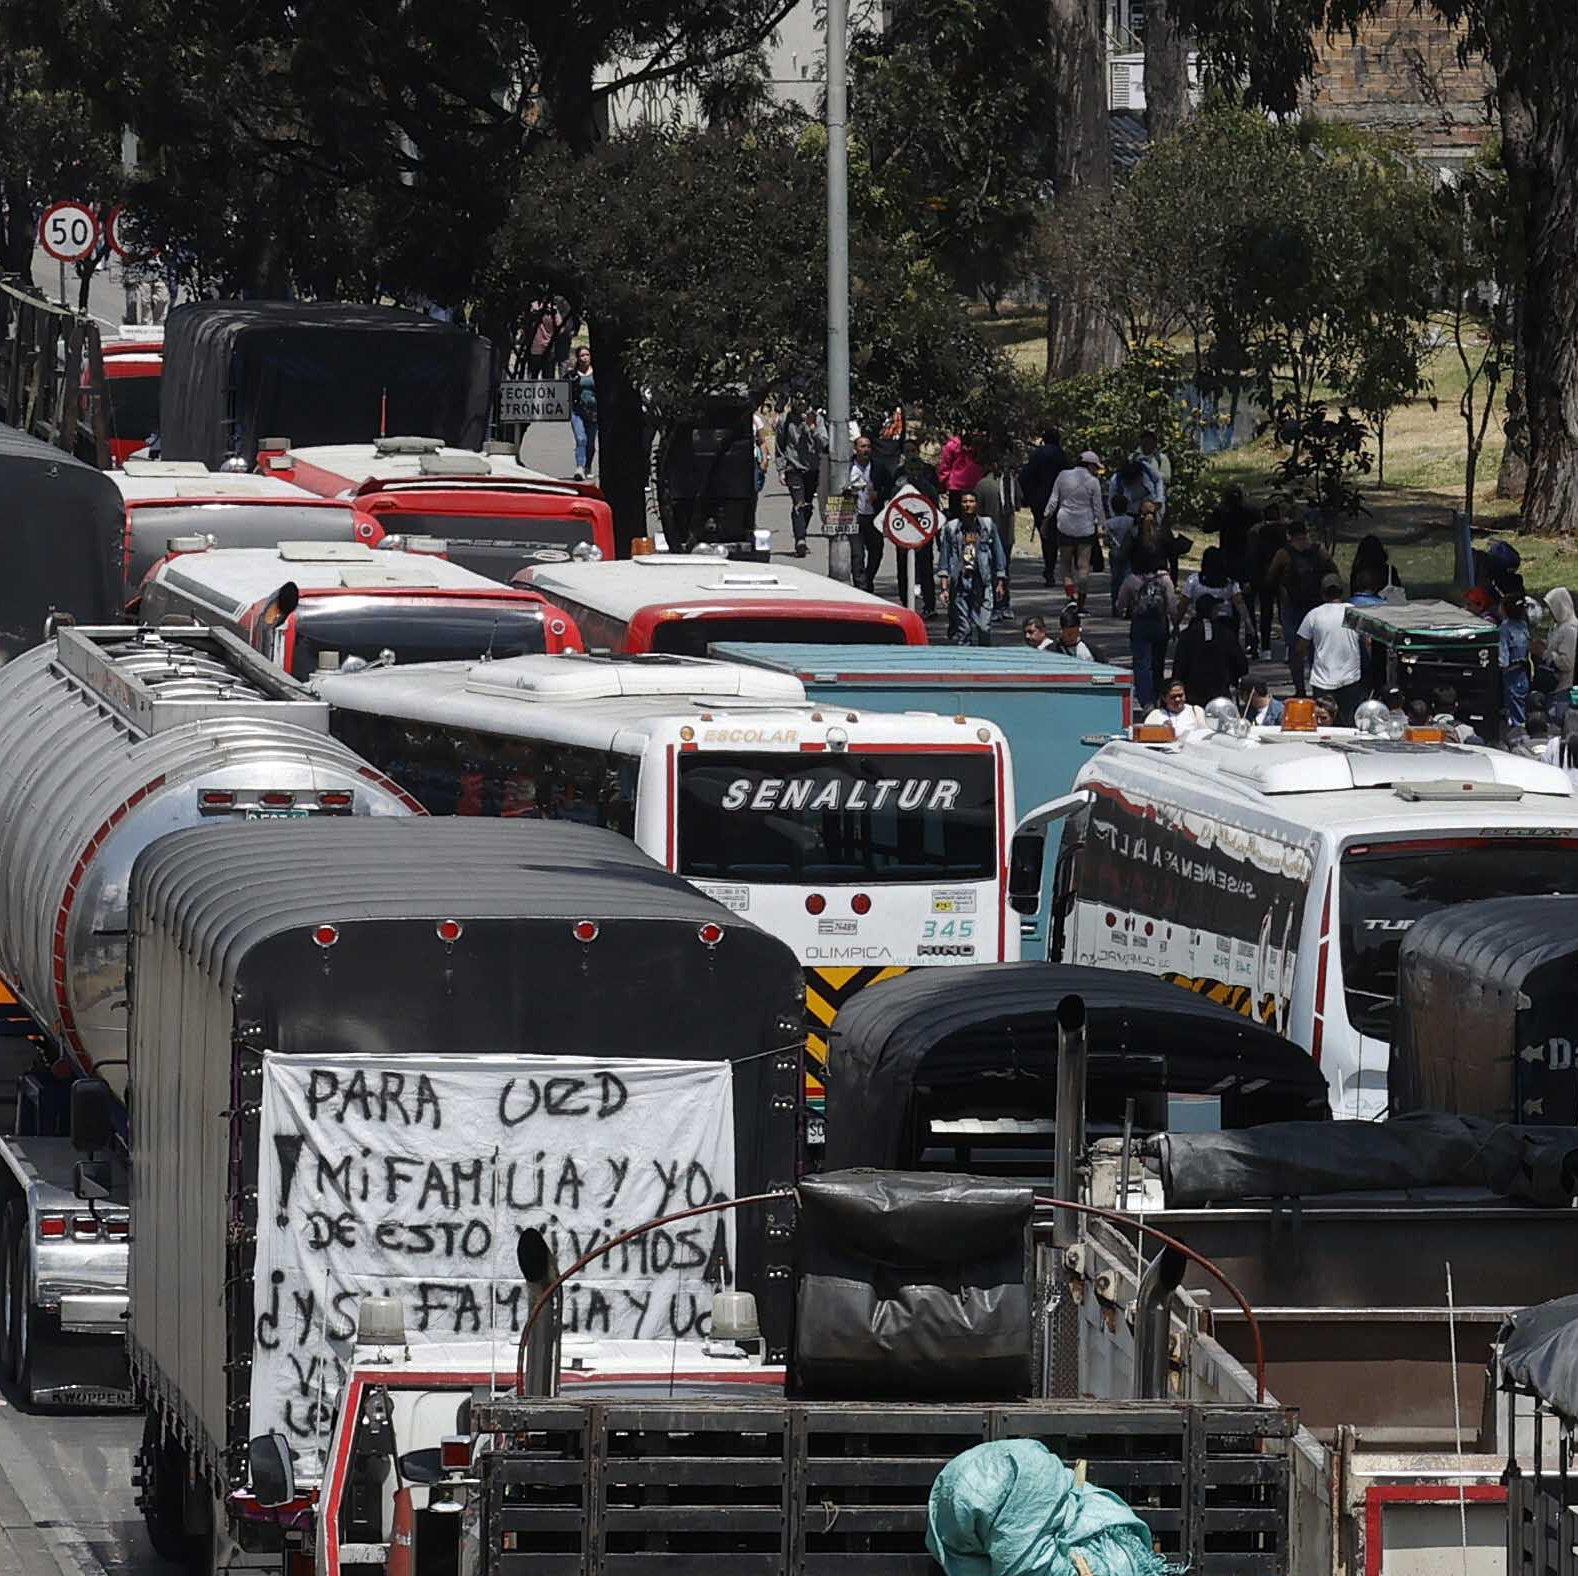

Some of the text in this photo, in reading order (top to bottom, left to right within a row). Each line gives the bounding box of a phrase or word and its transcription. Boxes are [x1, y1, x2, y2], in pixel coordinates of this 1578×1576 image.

[52, 218, 88, 246] 50
[501, 383, 556, 399] TECCIÓN
[501, 400, 564, 415] TRÓNICA
[703, 729, 798, 743] ESCOLAR
[722, 779, 961, 811] SENALTUR
[1478, 827, 1573, 838] ESCOLAR
[922, 919, 975, 938] 345
[805, 946, 892, 960] OLIMPICA
[917, 944, 975, 957] HINO
[307, 1069, 441, 1130] PARA
[308, 1211, 357, 1250] DE
